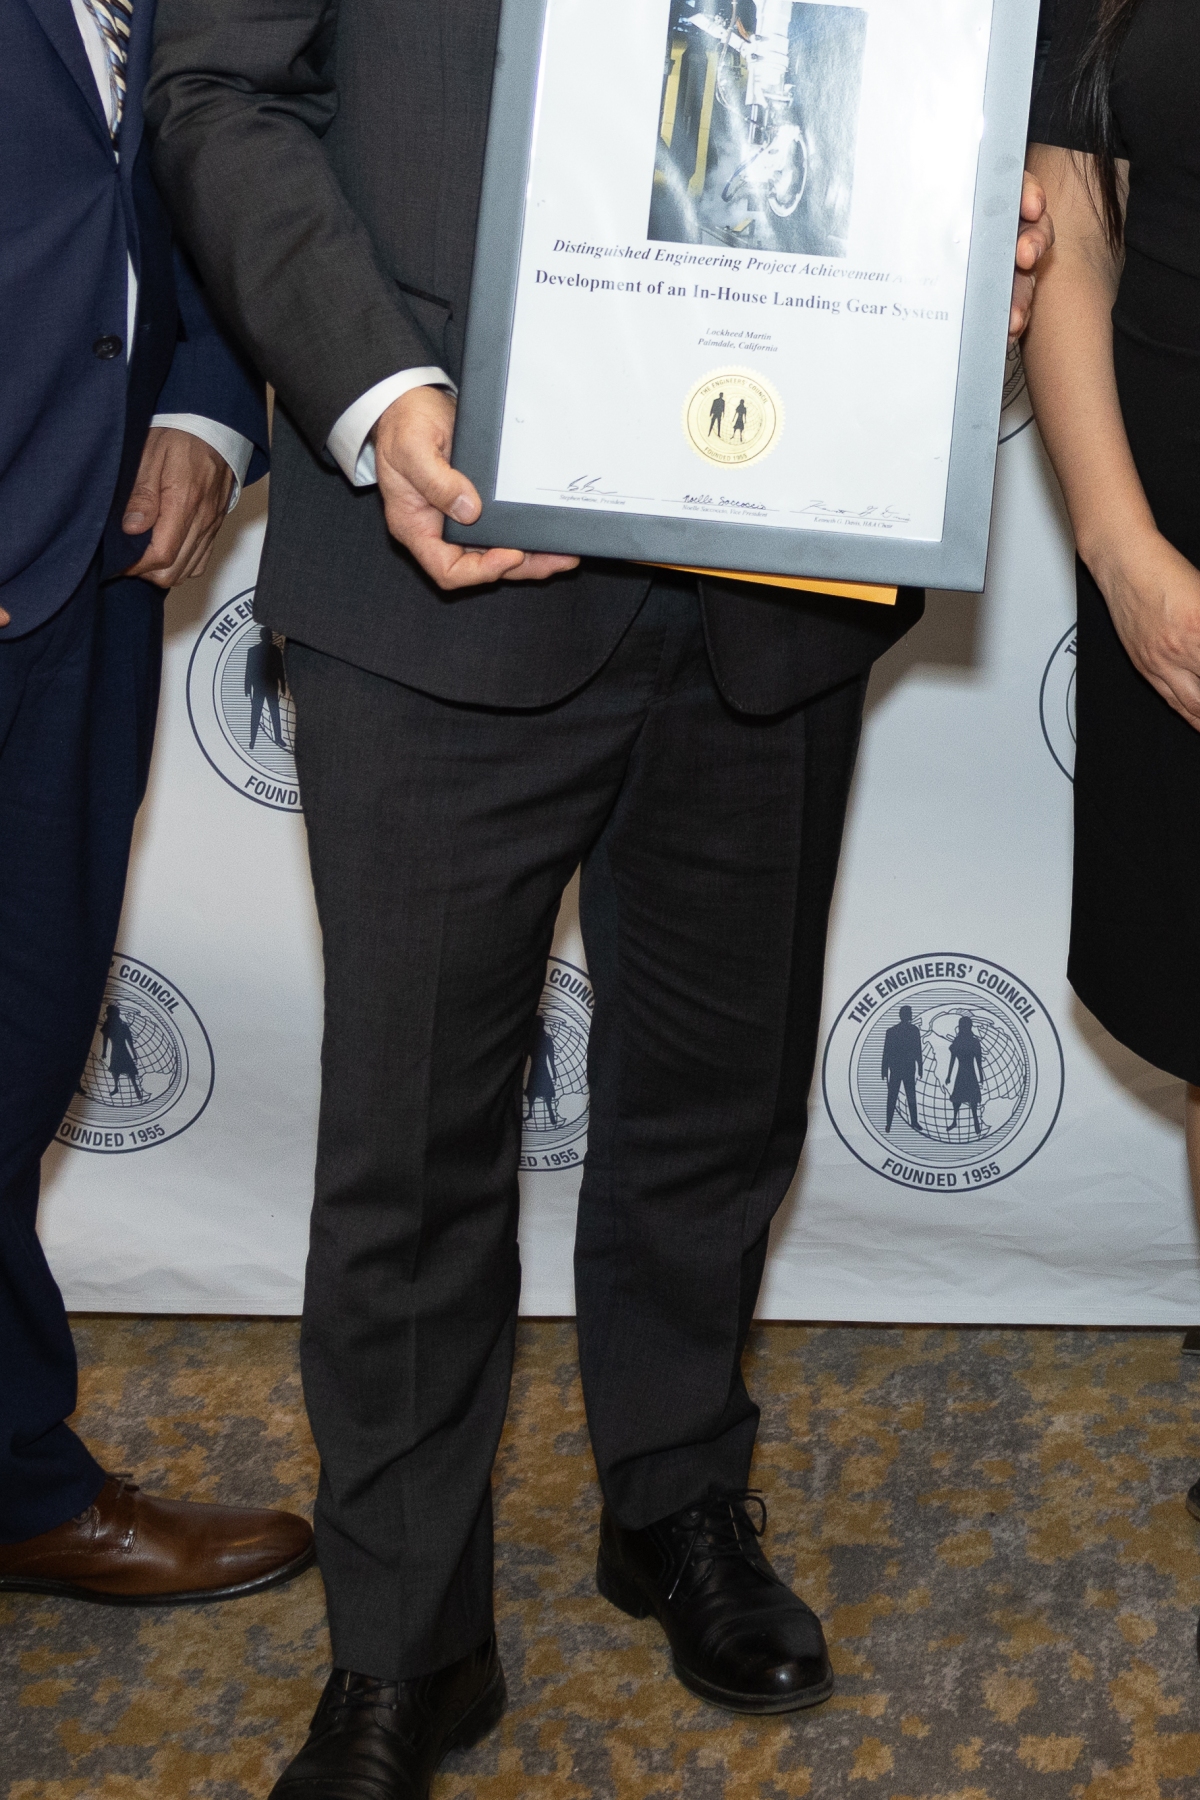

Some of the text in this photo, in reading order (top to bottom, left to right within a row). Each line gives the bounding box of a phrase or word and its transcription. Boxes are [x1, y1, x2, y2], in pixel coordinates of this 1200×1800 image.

[552, 239, 652, 260] Distinguished
[654, 248, 742, 271] Engineering
[746, 257, 797, 274] Project
[800, 262, 890, 283] Achievement
[535, 270, 949, 321] Development of an In-House Landing Gear System
[698, 338, 778, 352] Palmdale, California
[706, 328, 772, 340] Lockheed Martin
[209, 614, 239, 643] THE
[244, 774, 300, 805] FOUND
[119, 964, 180, 1014] COUNCIL
[549, 968, 596, 1011] COUNC
[848, 961, 1036, 1024] THE ENGINEERS' COUNCIL
[61, 1121, 165, 1146] OUNDED 1955
[542, 1148, 579, 1167] 1955
[881, 1158, 1000, 1187] FOUNDED 1955
